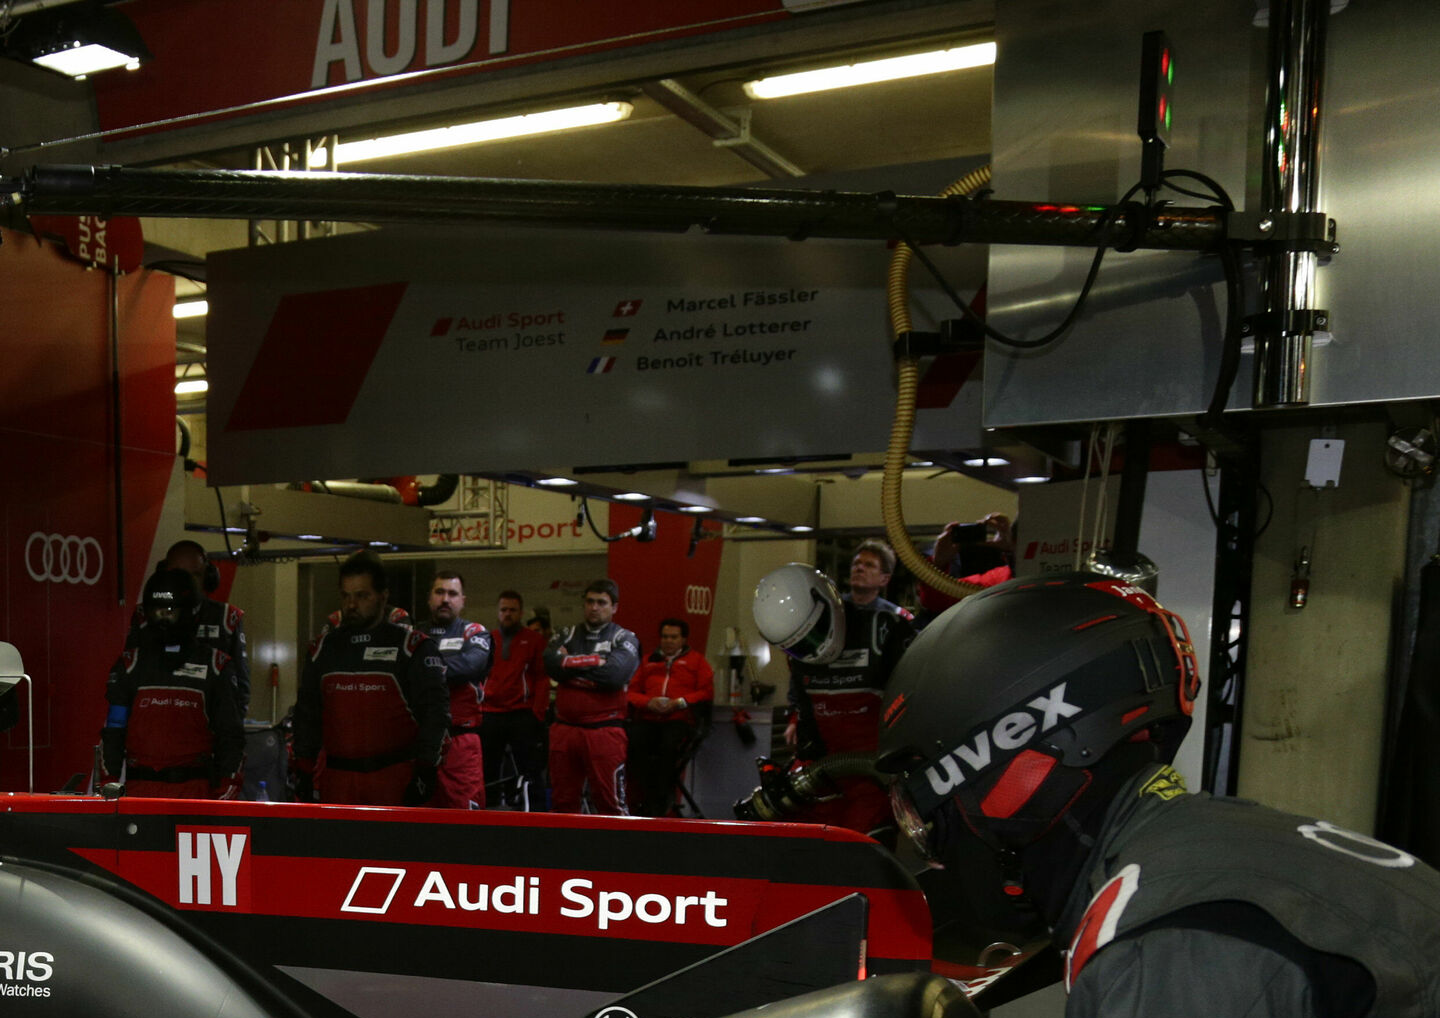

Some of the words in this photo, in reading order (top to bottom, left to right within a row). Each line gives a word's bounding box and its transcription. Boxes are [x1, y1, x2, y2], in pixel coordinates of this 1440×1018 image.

[311, 0, 509, 88] AUDI
[666, 294, 736, 313] Marcel
[743, 288, 819, 307] Fässler
[455, 313, 502, 331] Audi
[507, 311, 565, 330] Sport
[653, 323, 716, 343] André
[723, 319, 812, 338] Lotterer
[455, 336, 508, 352] Team
[514, 332, 566, 350] Joest
[636, 353, 703, 371] Benoît
[711, 349, 796, 366] Tréluyer
[925, 682, 1083, 795] uvex
[178, 832, 247, 906] HY
[413, 870, 540, 915] Audi
[560, 878, 728, 930] Sport
